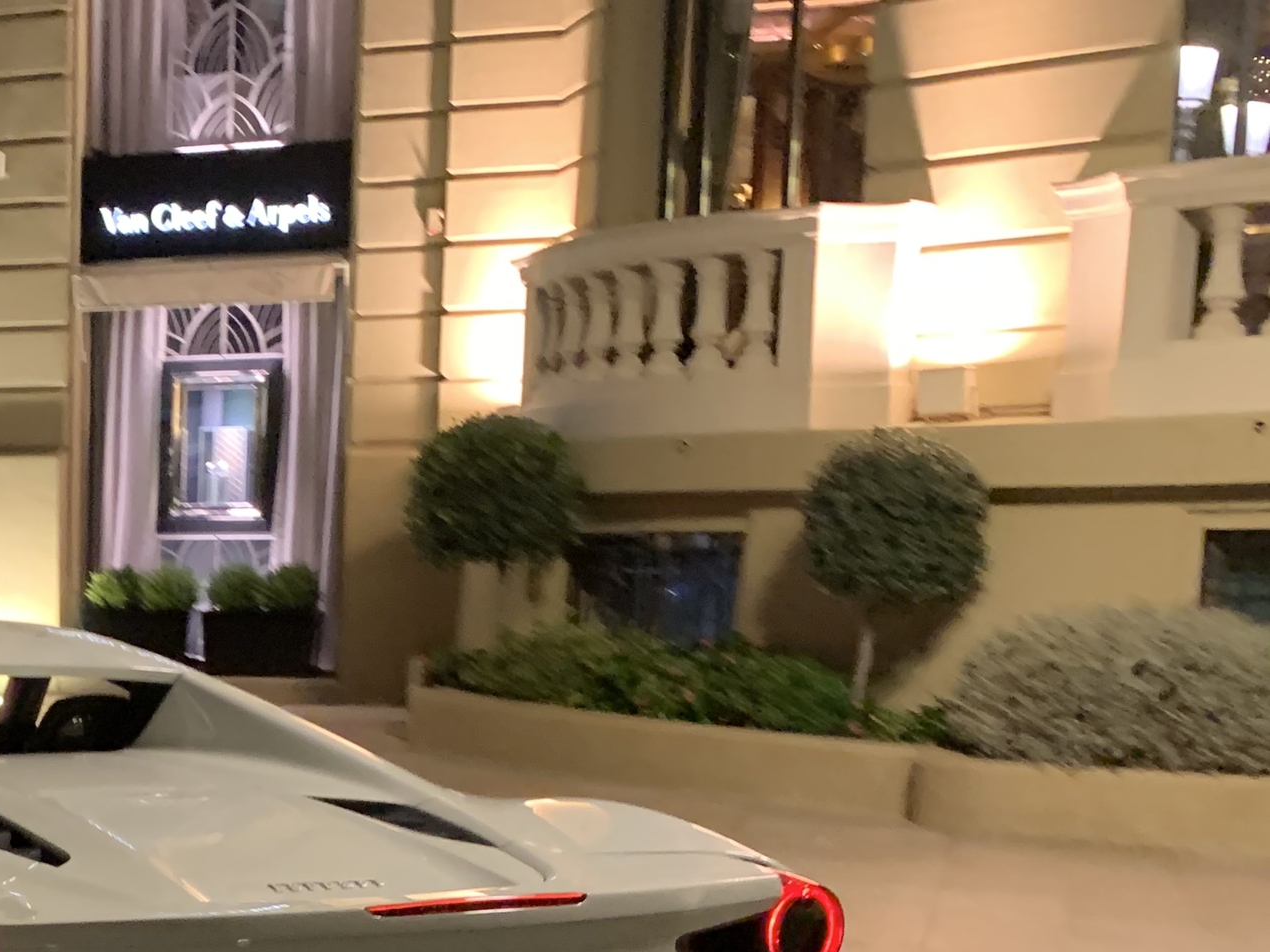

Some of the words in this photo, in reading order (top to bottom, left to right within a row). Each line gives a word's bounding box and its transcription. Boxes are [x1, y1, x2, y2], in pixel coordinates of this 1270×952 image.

[99, 207, 150, 236] Van
[150, 200, 222, 232] Cleef
[222, 204, 246, 229] &
[246, 194, 332, 234] Arpels
